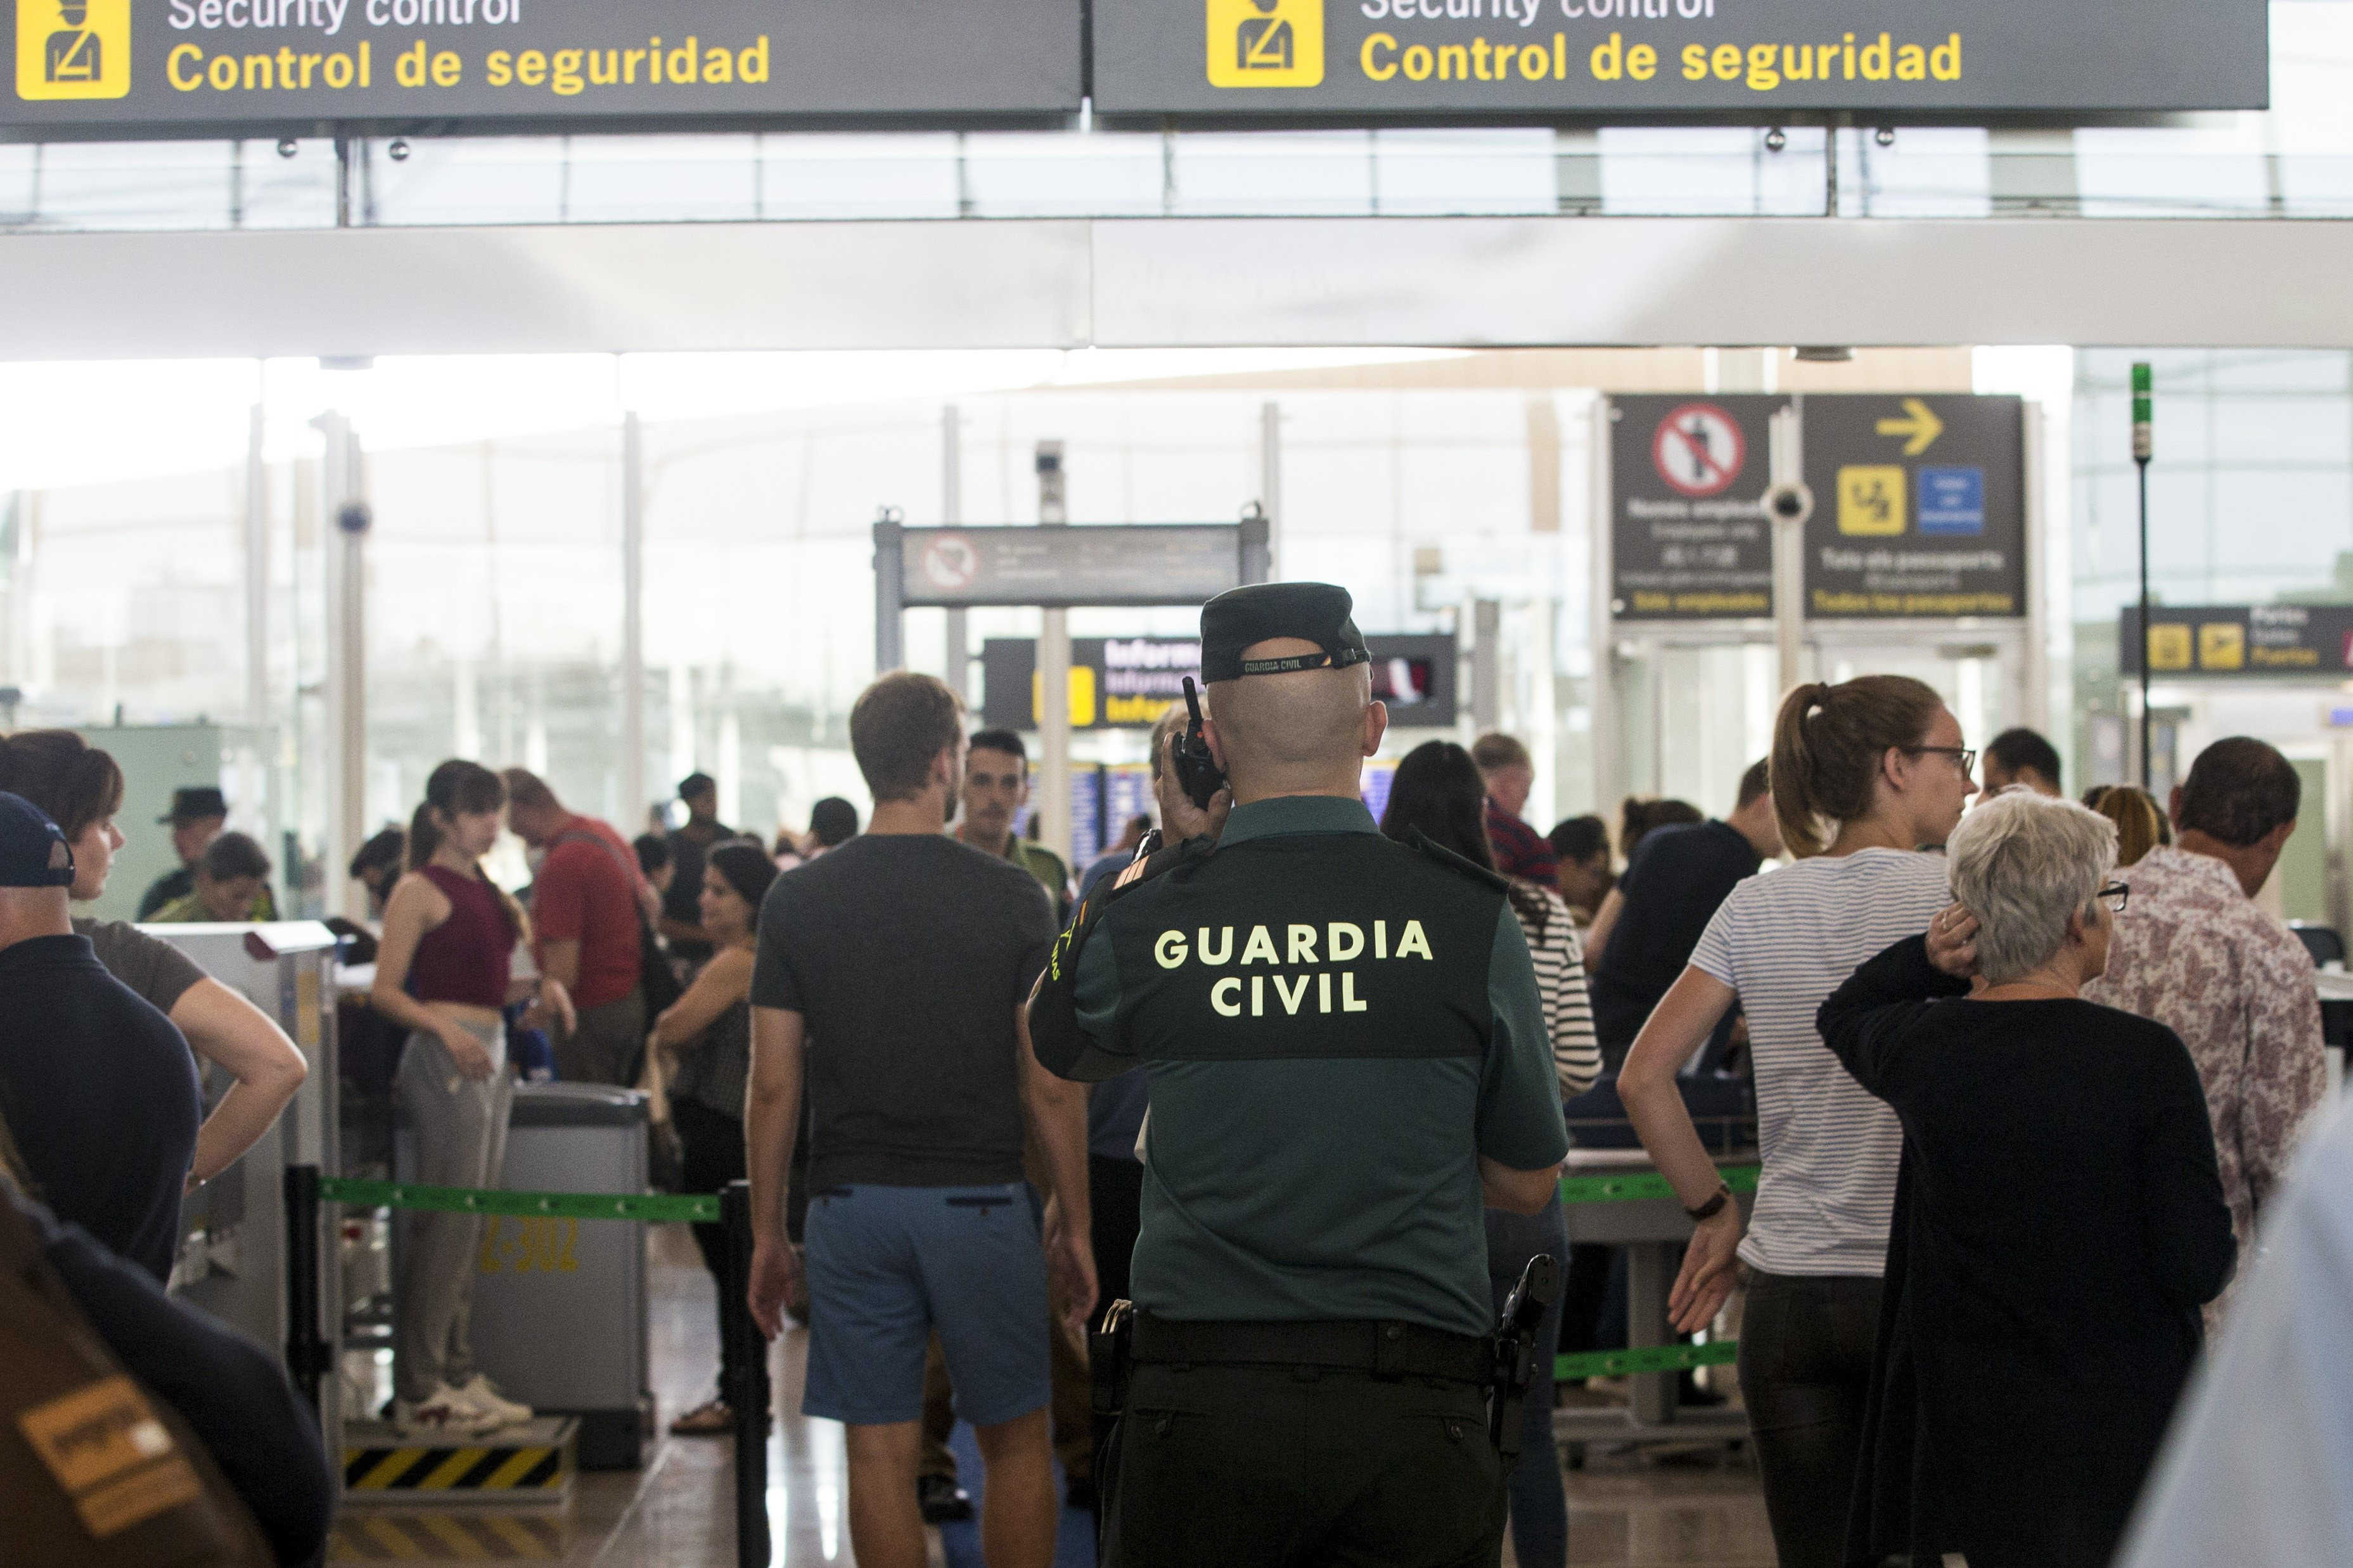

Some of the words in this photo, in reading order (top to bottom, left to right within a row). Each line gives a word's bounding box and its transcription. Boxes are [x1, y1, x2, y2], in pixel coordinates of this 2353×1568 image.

[168, 0, 349, 35] Security
[167, 40, 371, 91] Control
[395, 39, 462, 87] de
[487, 34, 769, 96] seguridad
[1361, 32, 1566, 81] Control
[1590, 32, 1657, 80] de
[1681, 32, 1961, 91] seguridad
[1245, 660, 1279, 673] GUARDIA
[1280, 659, 1302, 670] CIVIL
[1154, 919, 1433, 969] GUARDIA
[1210, 972, 1368, 1017] CIVIL
